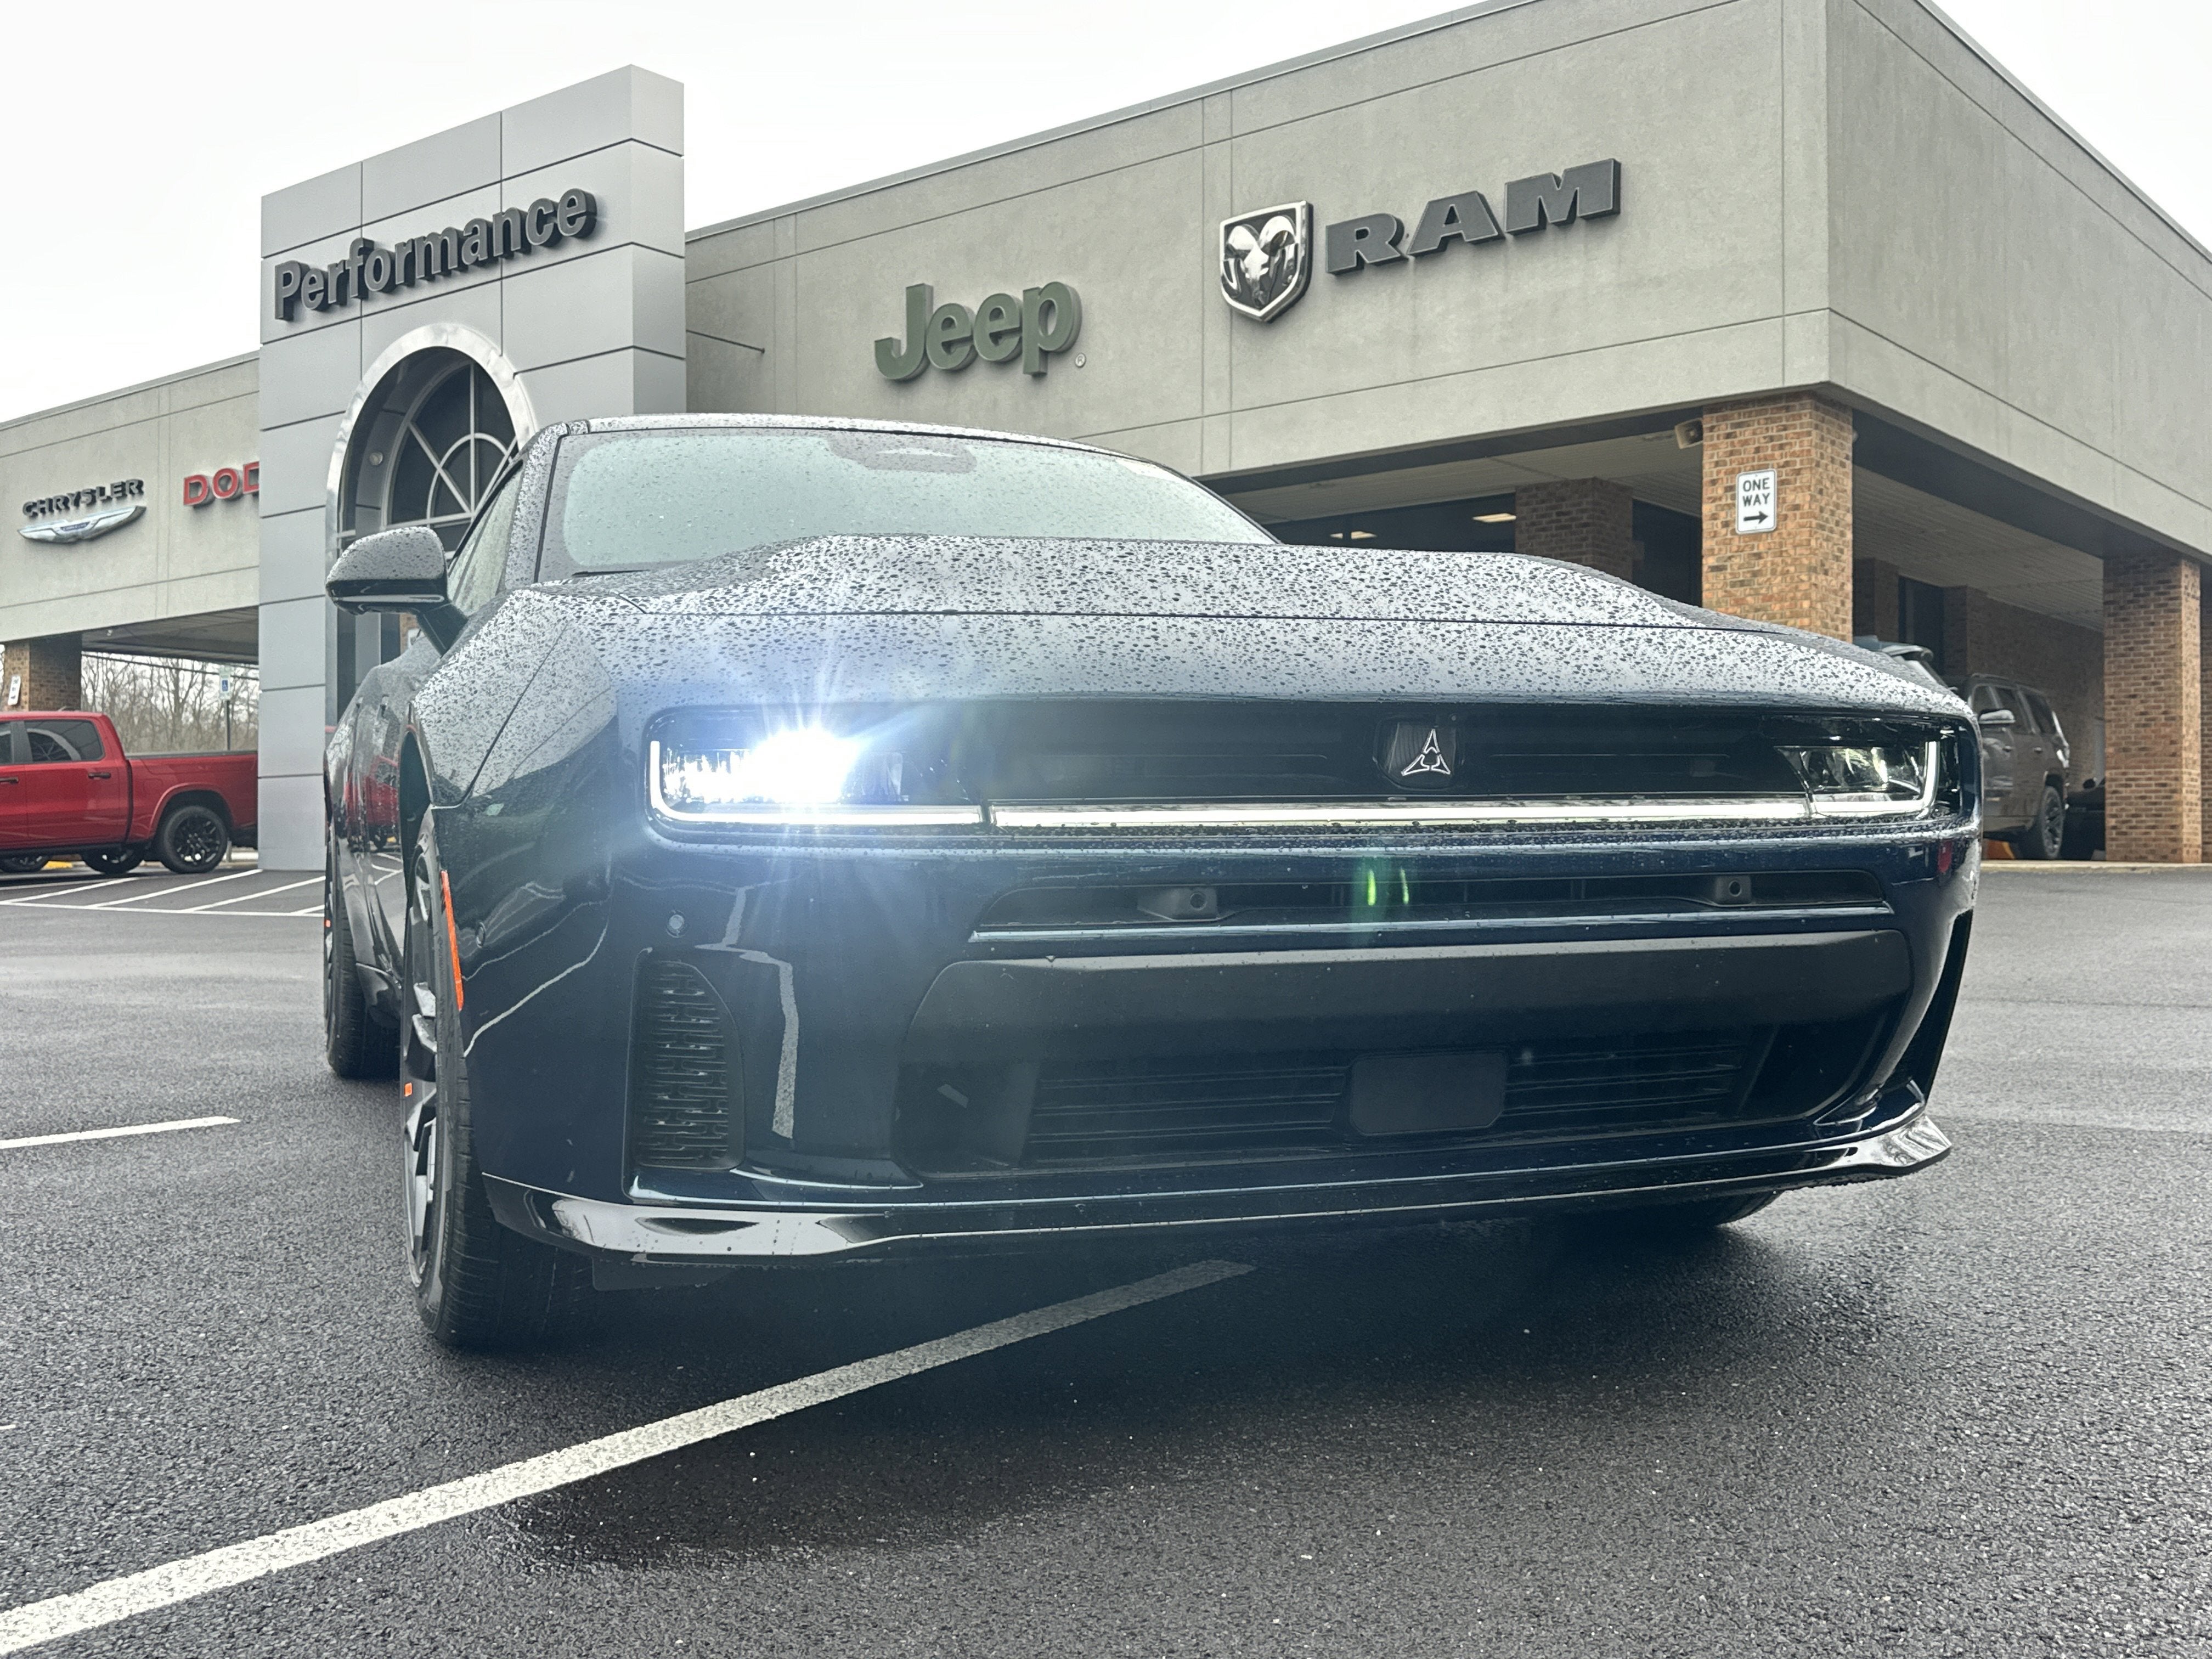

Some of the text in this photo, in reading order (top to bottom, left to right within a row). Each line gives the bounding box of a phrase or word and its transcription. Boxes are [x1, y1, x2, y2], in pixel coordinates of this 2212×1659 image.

[1325, 158, 1621, 275] RAM
[274, 188, 597, 321] Performance
[874, 281, 1082, 381] Jeep
[22, 479, 144, 517] CHRYSLER
[1742, 493, 1770, 507] WAY
[1743, 477, 1770, 492] ONE
